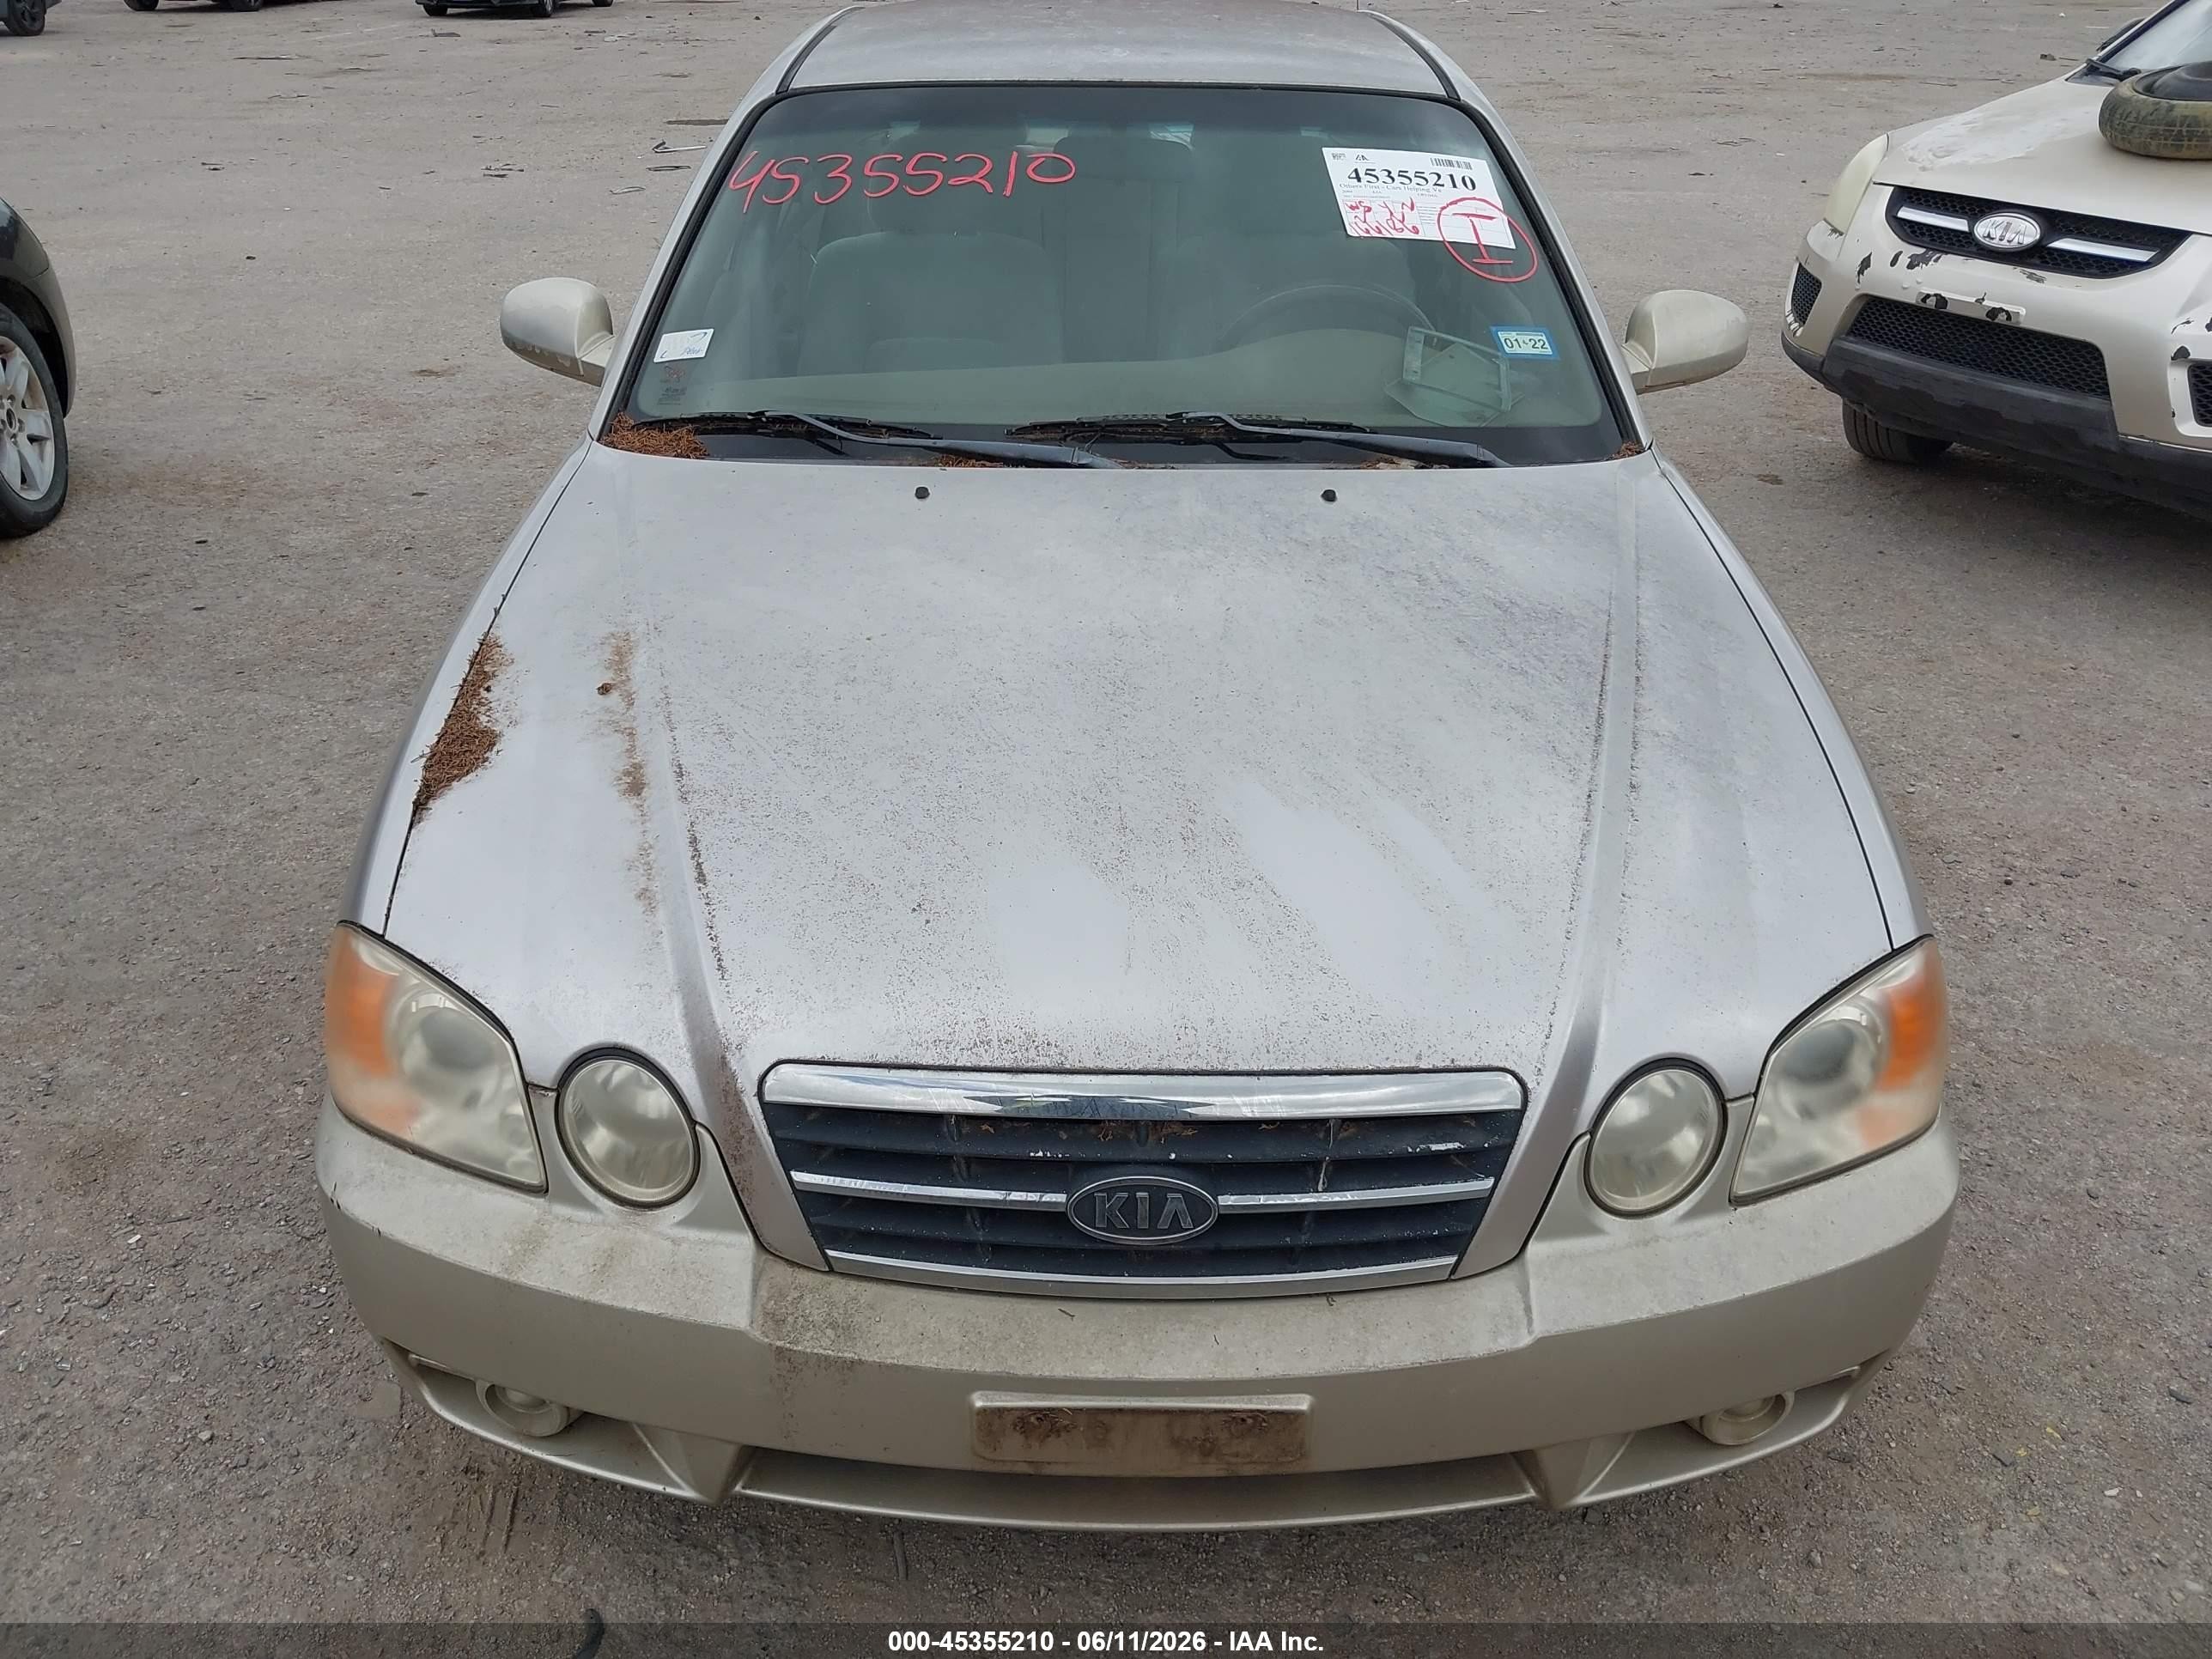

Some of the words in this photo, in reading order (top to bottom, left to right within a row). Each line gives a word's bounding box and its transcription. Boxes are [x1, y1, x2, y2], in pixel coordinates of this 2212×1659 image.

[727, 150, 1076, 214] 45355210
[1347, 167, 1476, 191] 45355210
[1982, 219, 2027, 245] KIA
[1094, 1192, 1194, 1229] KIA
